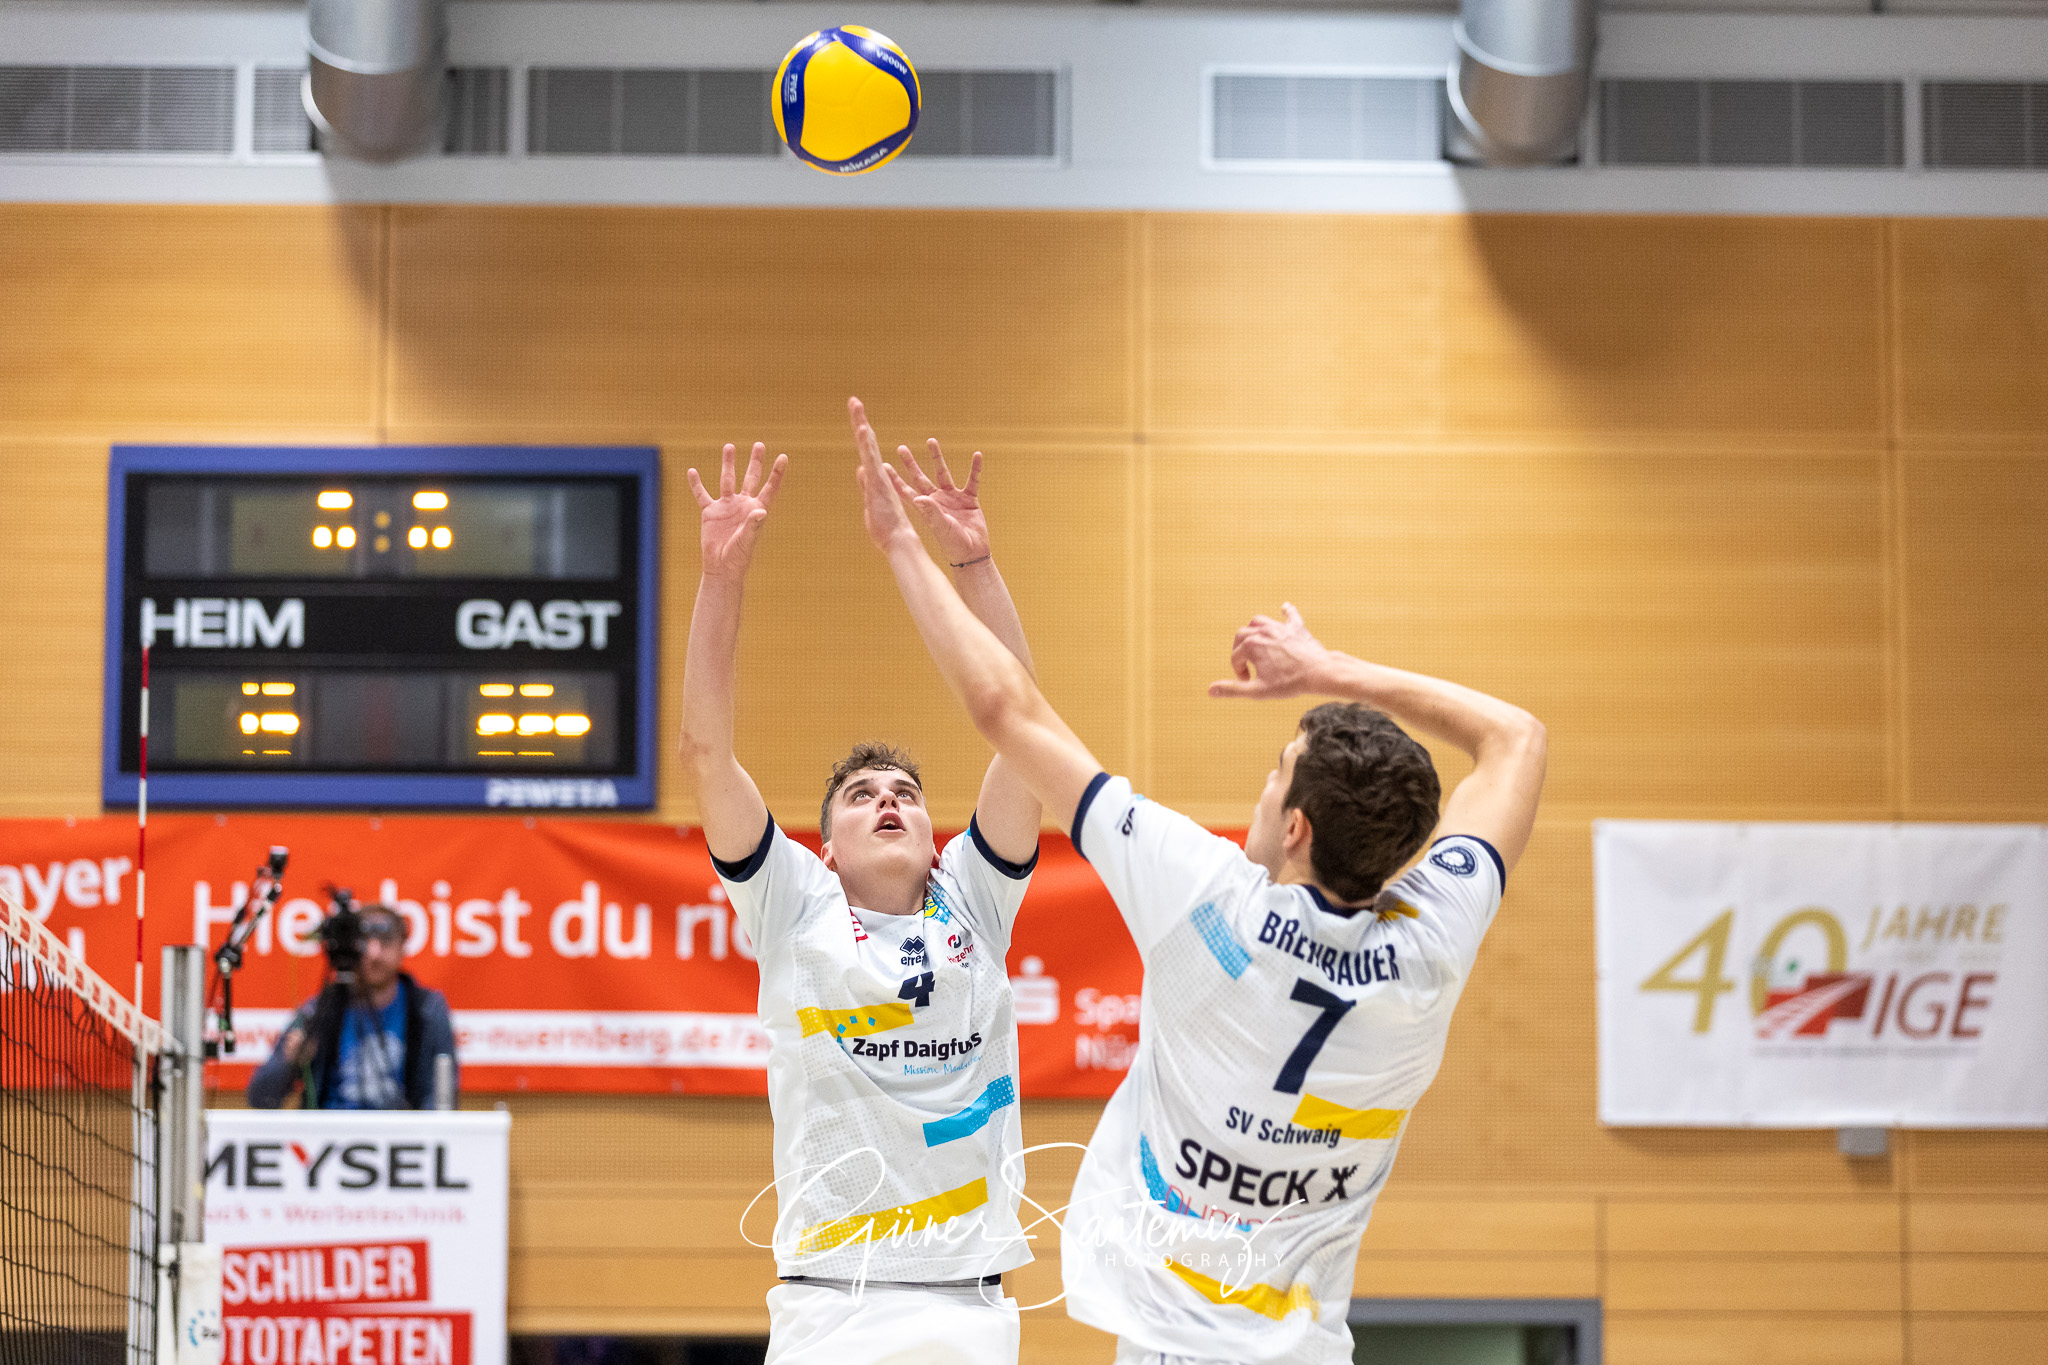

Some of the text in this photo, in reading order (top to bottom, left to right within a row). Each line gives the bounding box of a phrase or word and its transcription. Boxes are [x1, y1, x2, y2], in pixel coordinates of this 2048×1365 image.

[876, 50, 908, 75] V200W
[140, 598, 622, 650] HEIM GAST
[551, 881, 662, 959] du
[897, 970, 936, 1008] 4
[1638, 902, 2008, 1037] 40 JAHRE
[1871, 970, 1998, 1040] IGE
[852, 1037, 900, 1062] Zapf
[1273, 977, 1357, 1096] 7
[1225, 1105, 1343, 1150] SV Schwaig
[1175, 1138, 1319, 1208] SPECK
[222, 1245, 418, 1304] SCHILDER
